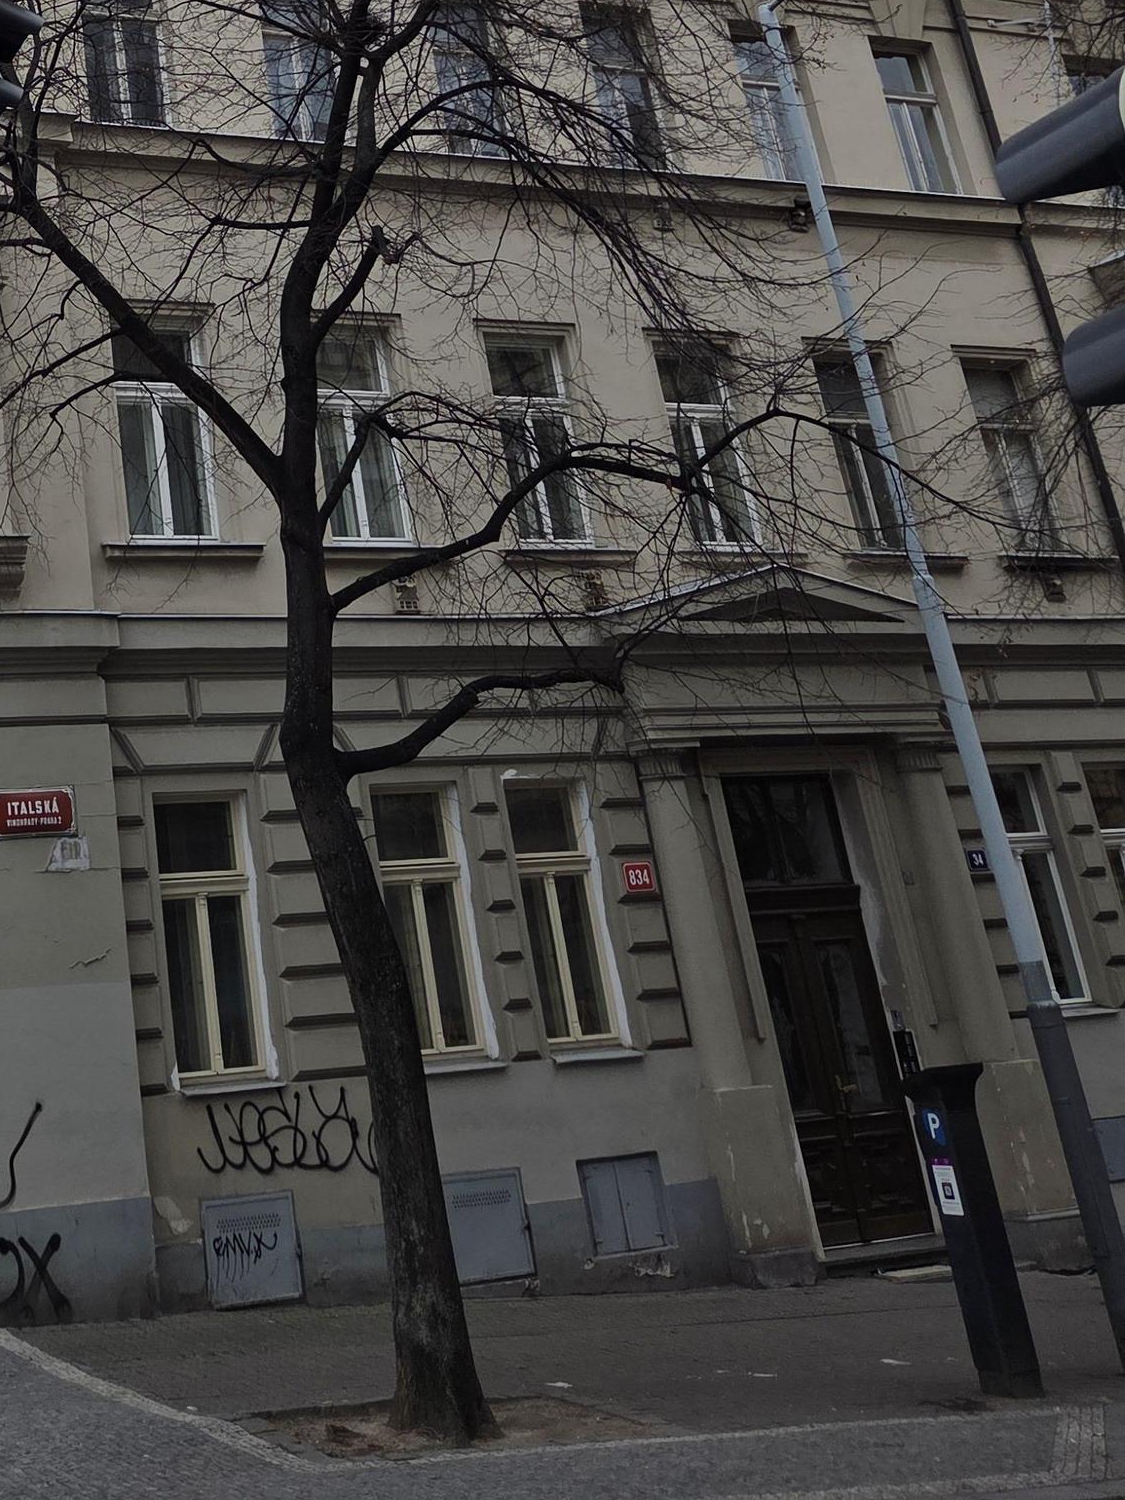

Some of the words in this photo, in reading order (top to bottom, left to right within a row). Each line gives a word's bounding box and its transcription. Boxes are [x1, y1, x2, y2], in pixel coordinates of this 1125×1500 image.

[7, 796, 60, 816] ITALSKÁ
[972, 852, 984, 866] 34
[628, 868, 650, 886] 834
[927, 1112, 940, 1140] P
